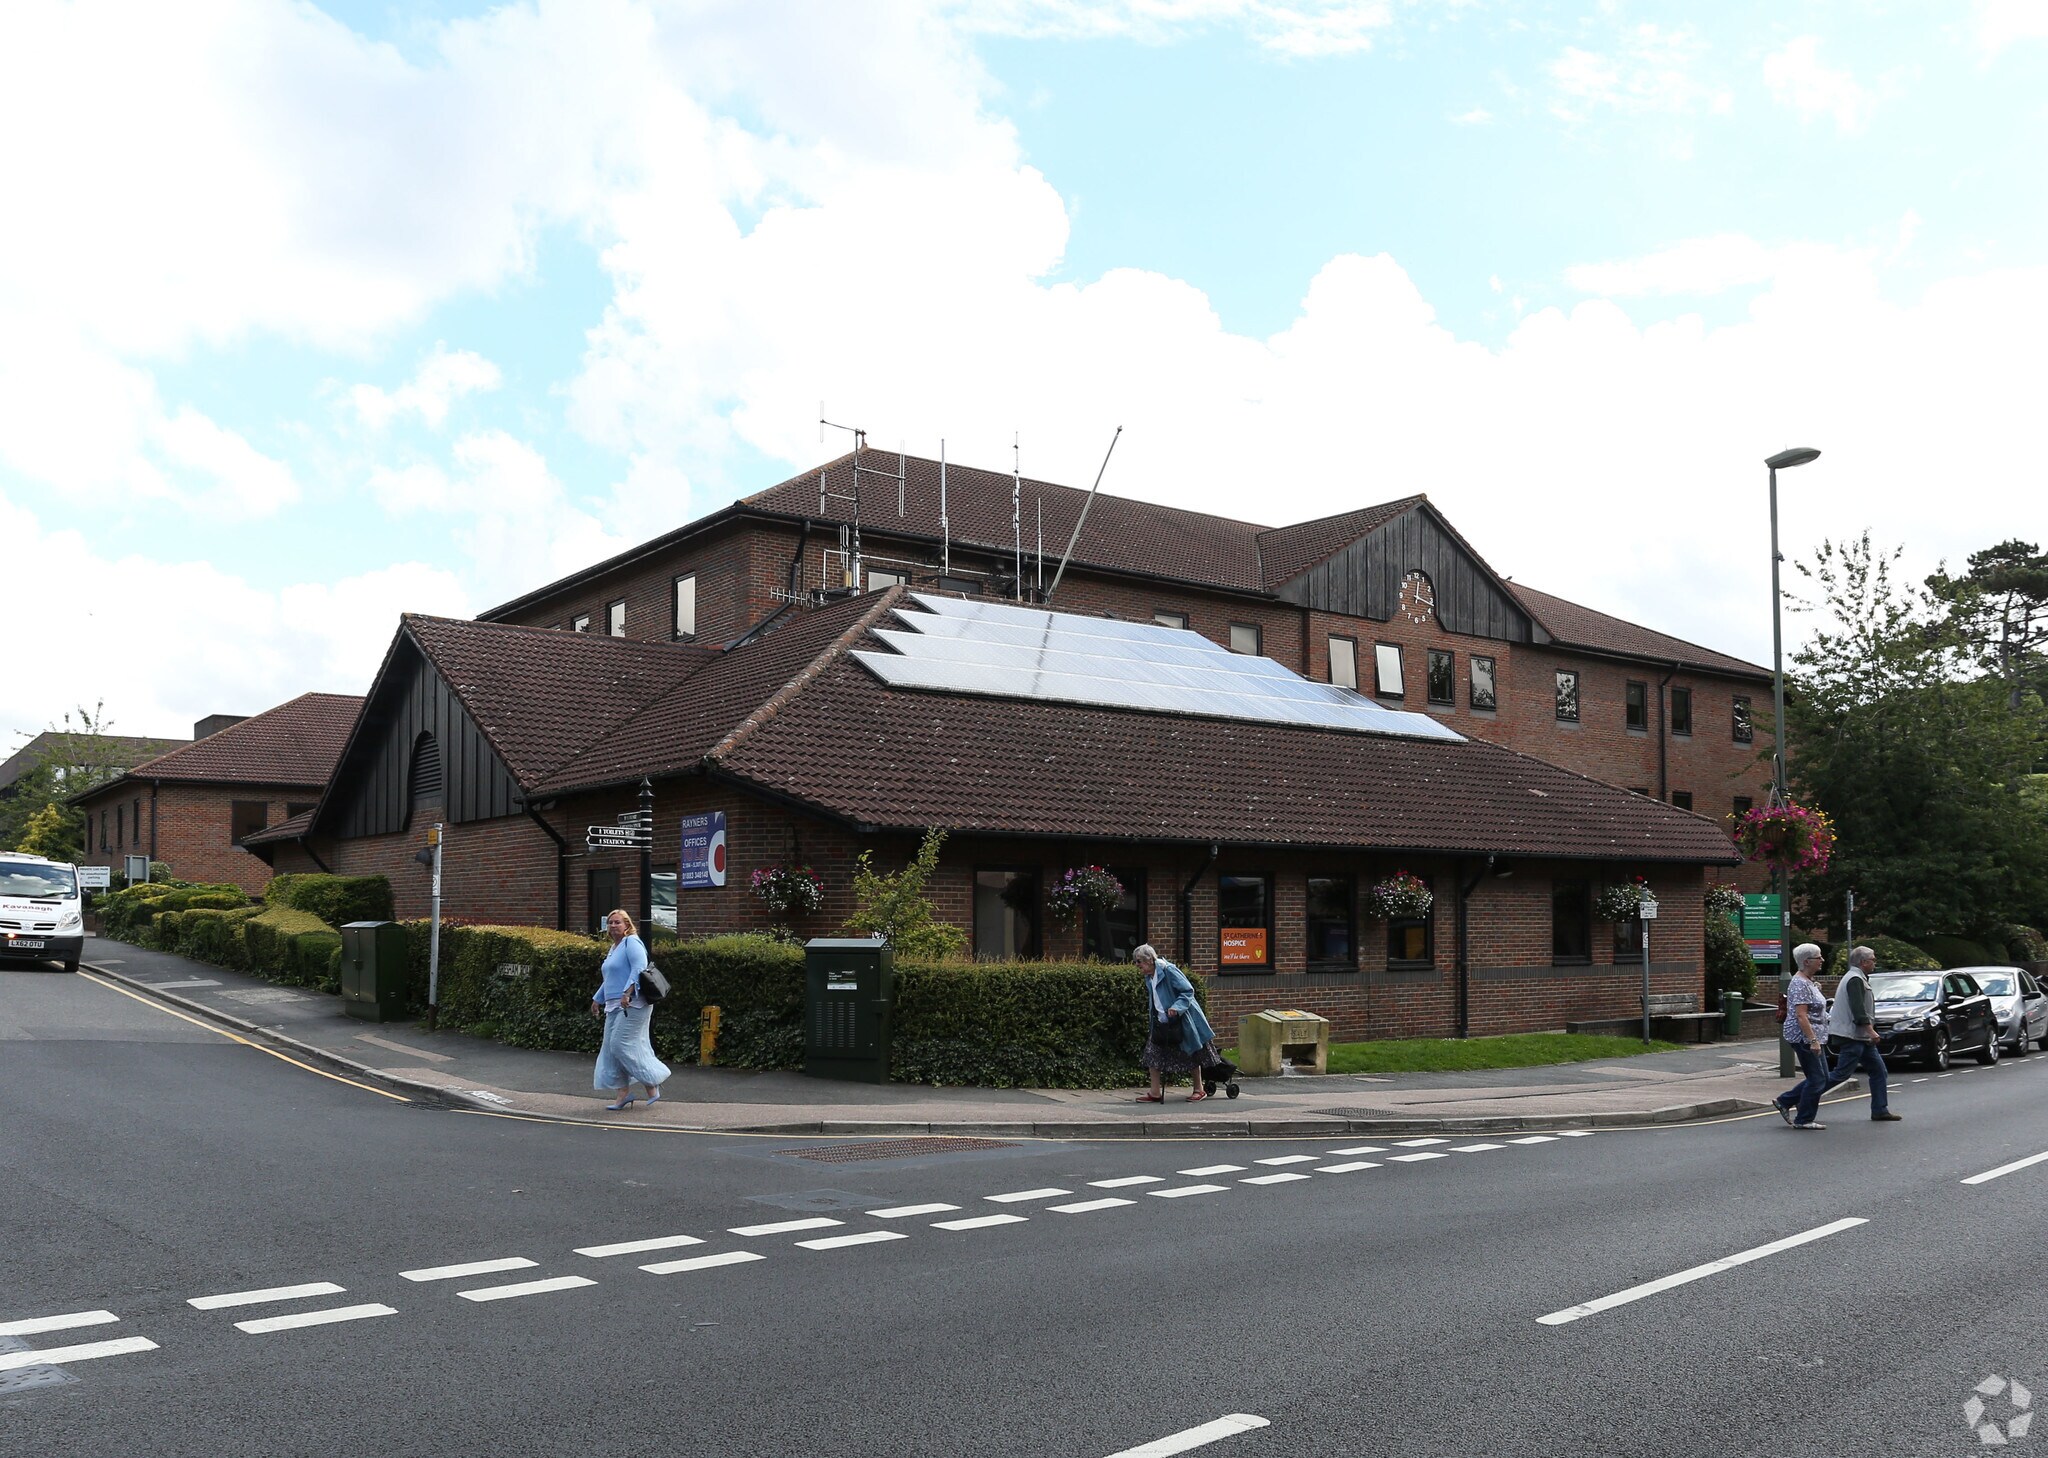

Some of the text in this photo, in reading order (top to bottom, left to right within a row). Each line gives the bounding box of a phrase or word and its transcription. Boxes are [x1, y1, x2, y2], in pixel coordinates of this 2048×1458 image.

[682, 816, 708, 828] RAYNERS
[684, 837, 707, 847] OFFICES
[682, 846, 708, 862] TO LET
[1292, 1028, 1308, 1038] SALT
